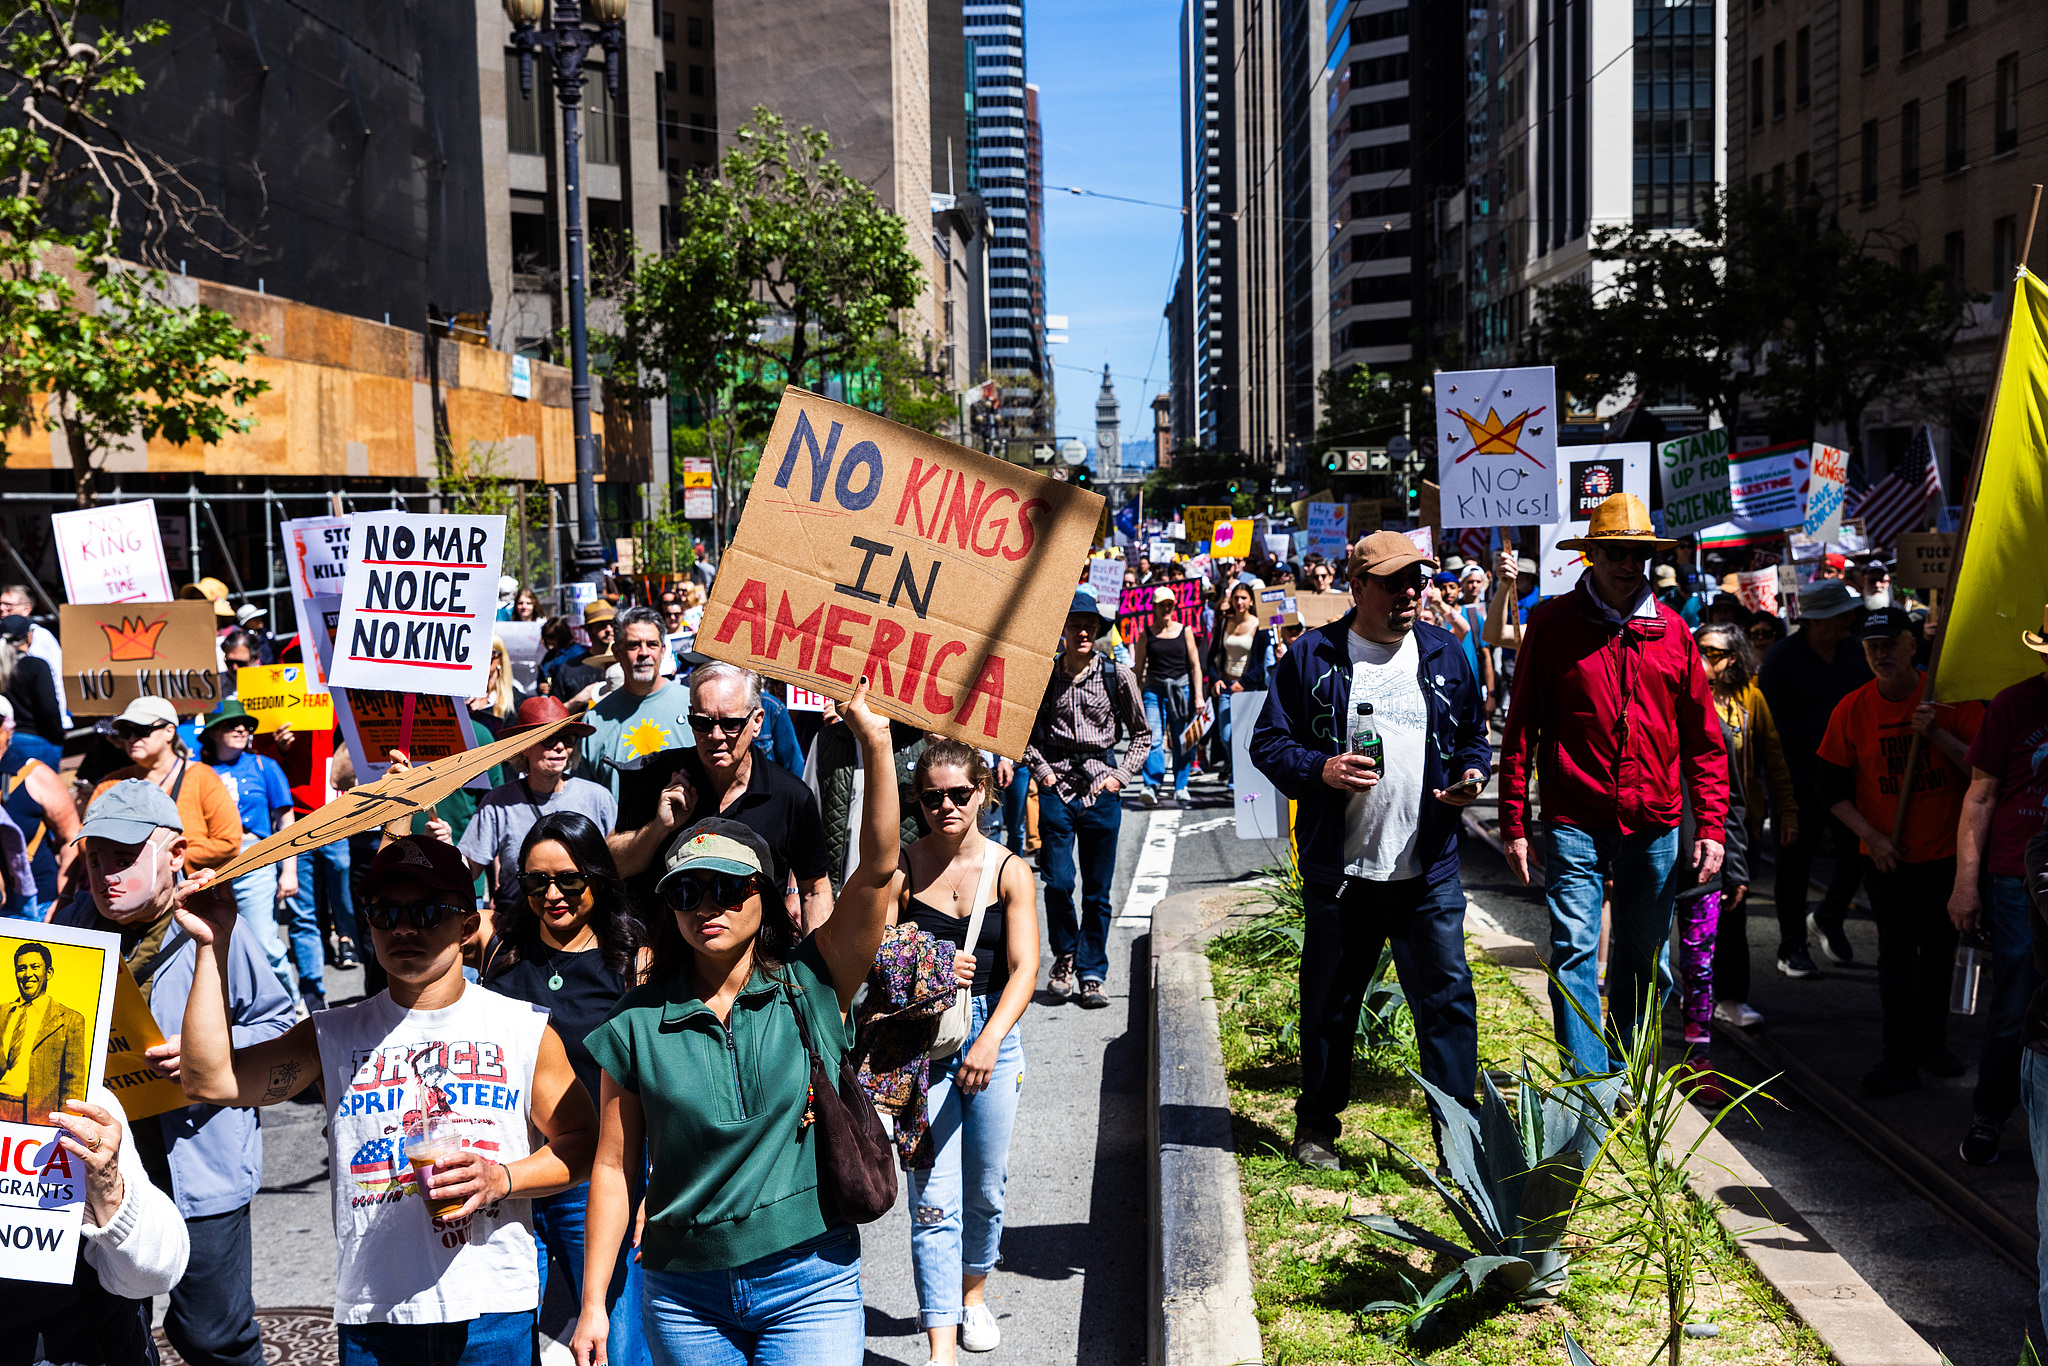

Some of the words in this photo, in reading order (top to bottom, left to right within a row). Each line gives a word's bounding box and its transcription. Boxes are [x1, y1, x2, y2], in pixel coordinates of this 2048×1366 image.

[1663, 429, 1728, 468] STAND
[1823, 446, 1841, 465] NO
[774, 408, 884, 511] NO
[894, 457, 1052, 561] KINGS
[1472, 466, 1521, 494] NO
[1671, 467, 1694, 489] UP
[1700, 455, 1729, 481] FOR
[1814, 459, 1846, 484] KINGS
[1457, 493, 1549, 519] KINGS!
[1580, 496, 1610, 509] FIGH
[1666, 486, 1733, 528] SCIENCE
[89, 516, 122, 535] NO
[81, 530, 141, 561] KING
[364, 525, 416, 561] NO
[423, 526, 488, 564] WAR
[1917, 547, 1950, 559] FUCK
[834, 536, 941, 619] IN
[1922, 562, 1945, 573] ICE
[105, 578, 137, 595] TIME
[365, 569, 418, 611] NO
[421, 570, 470, 613] ICE
[350, 618, 400, 659] NO
[403, 620, 472, 663] KING
[713, 578, 1006, 738] AMERICA
[78, 667, 114, 700] NO
[136, 668, 216, 699] KINGS
[243, 695, 284, 711] FREEDOM
[303, 694, 328, 708] FEAR
[418, 745, 451, 756] CRUELTY
[1879, 735, 1930, 756] TRU
[1887, 752, 1931, 775] MST
[1879, 776, 1898, 794] GO
[350, 1041, 507, 1091] BRUCE
